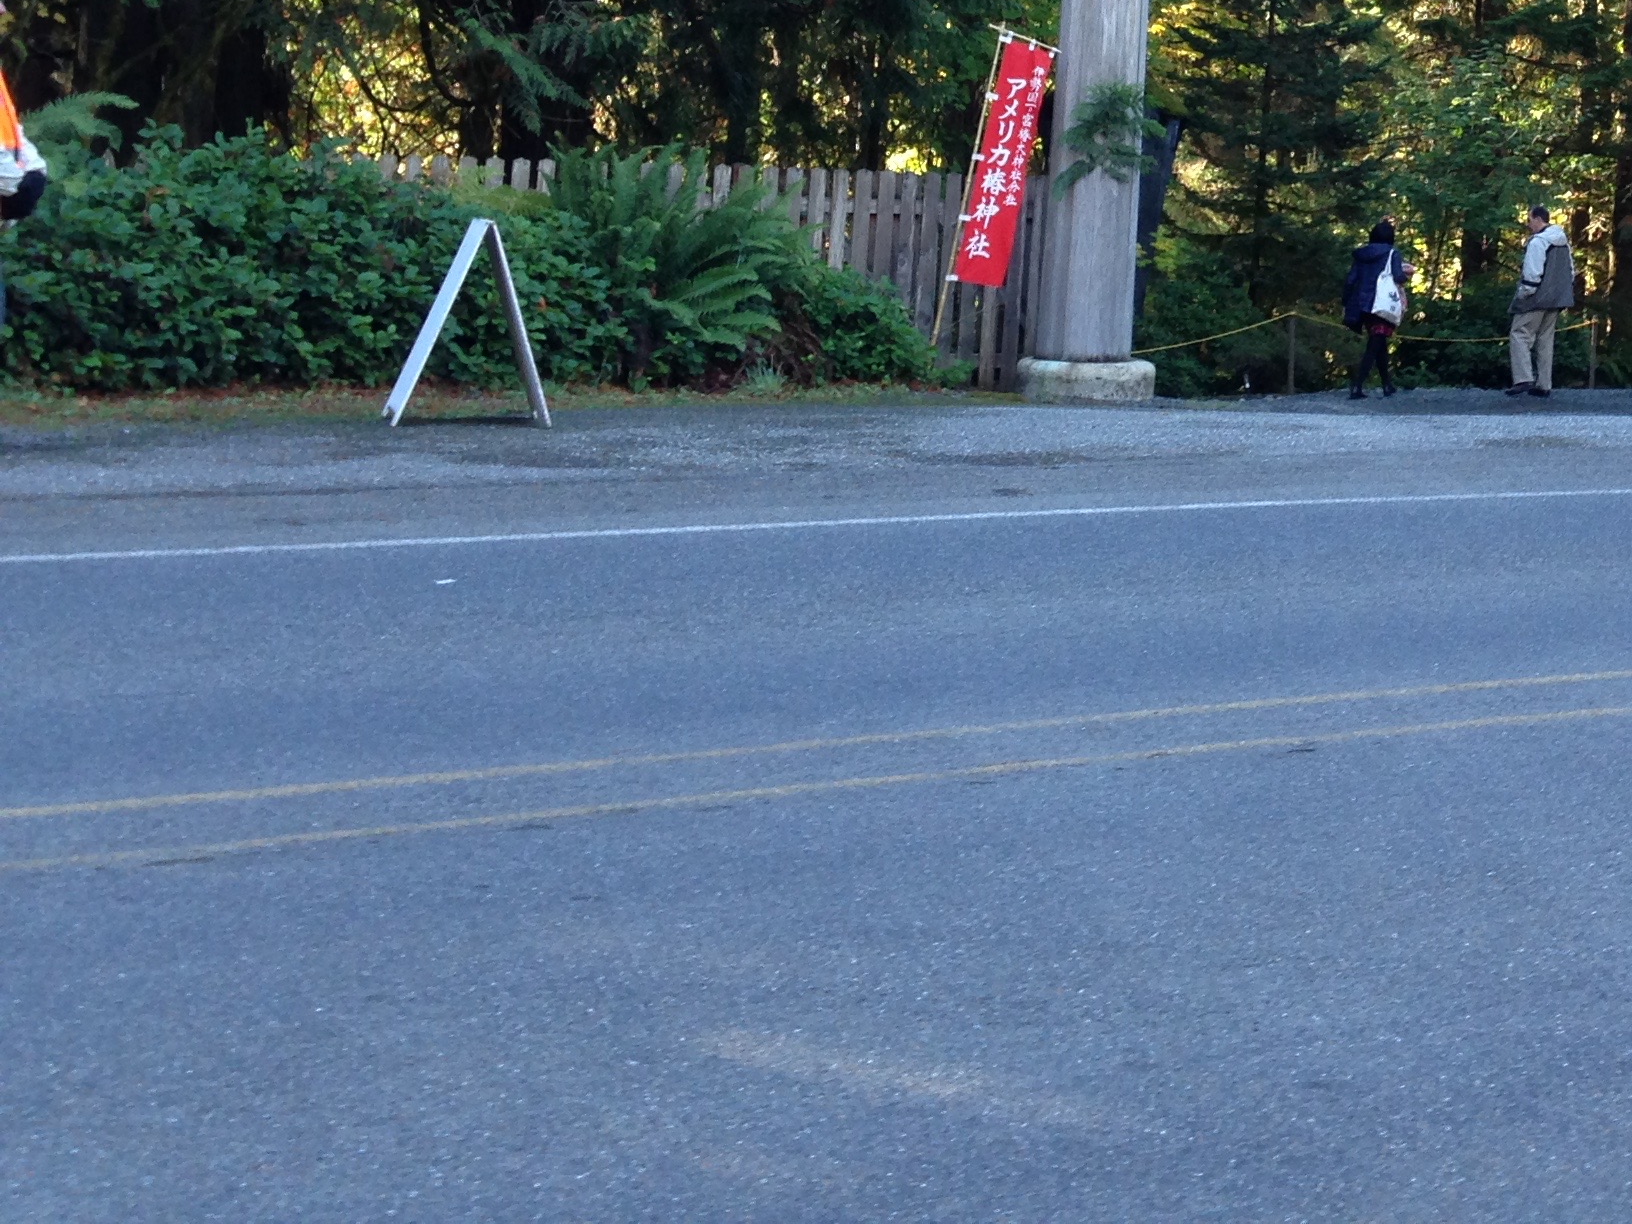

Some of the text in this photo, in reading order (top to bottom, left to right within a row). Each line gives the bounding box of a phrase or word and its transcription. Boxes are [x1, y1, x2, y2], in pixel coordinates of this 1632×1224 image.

[965, 77, 1027, 259] アメリカ椿神社
